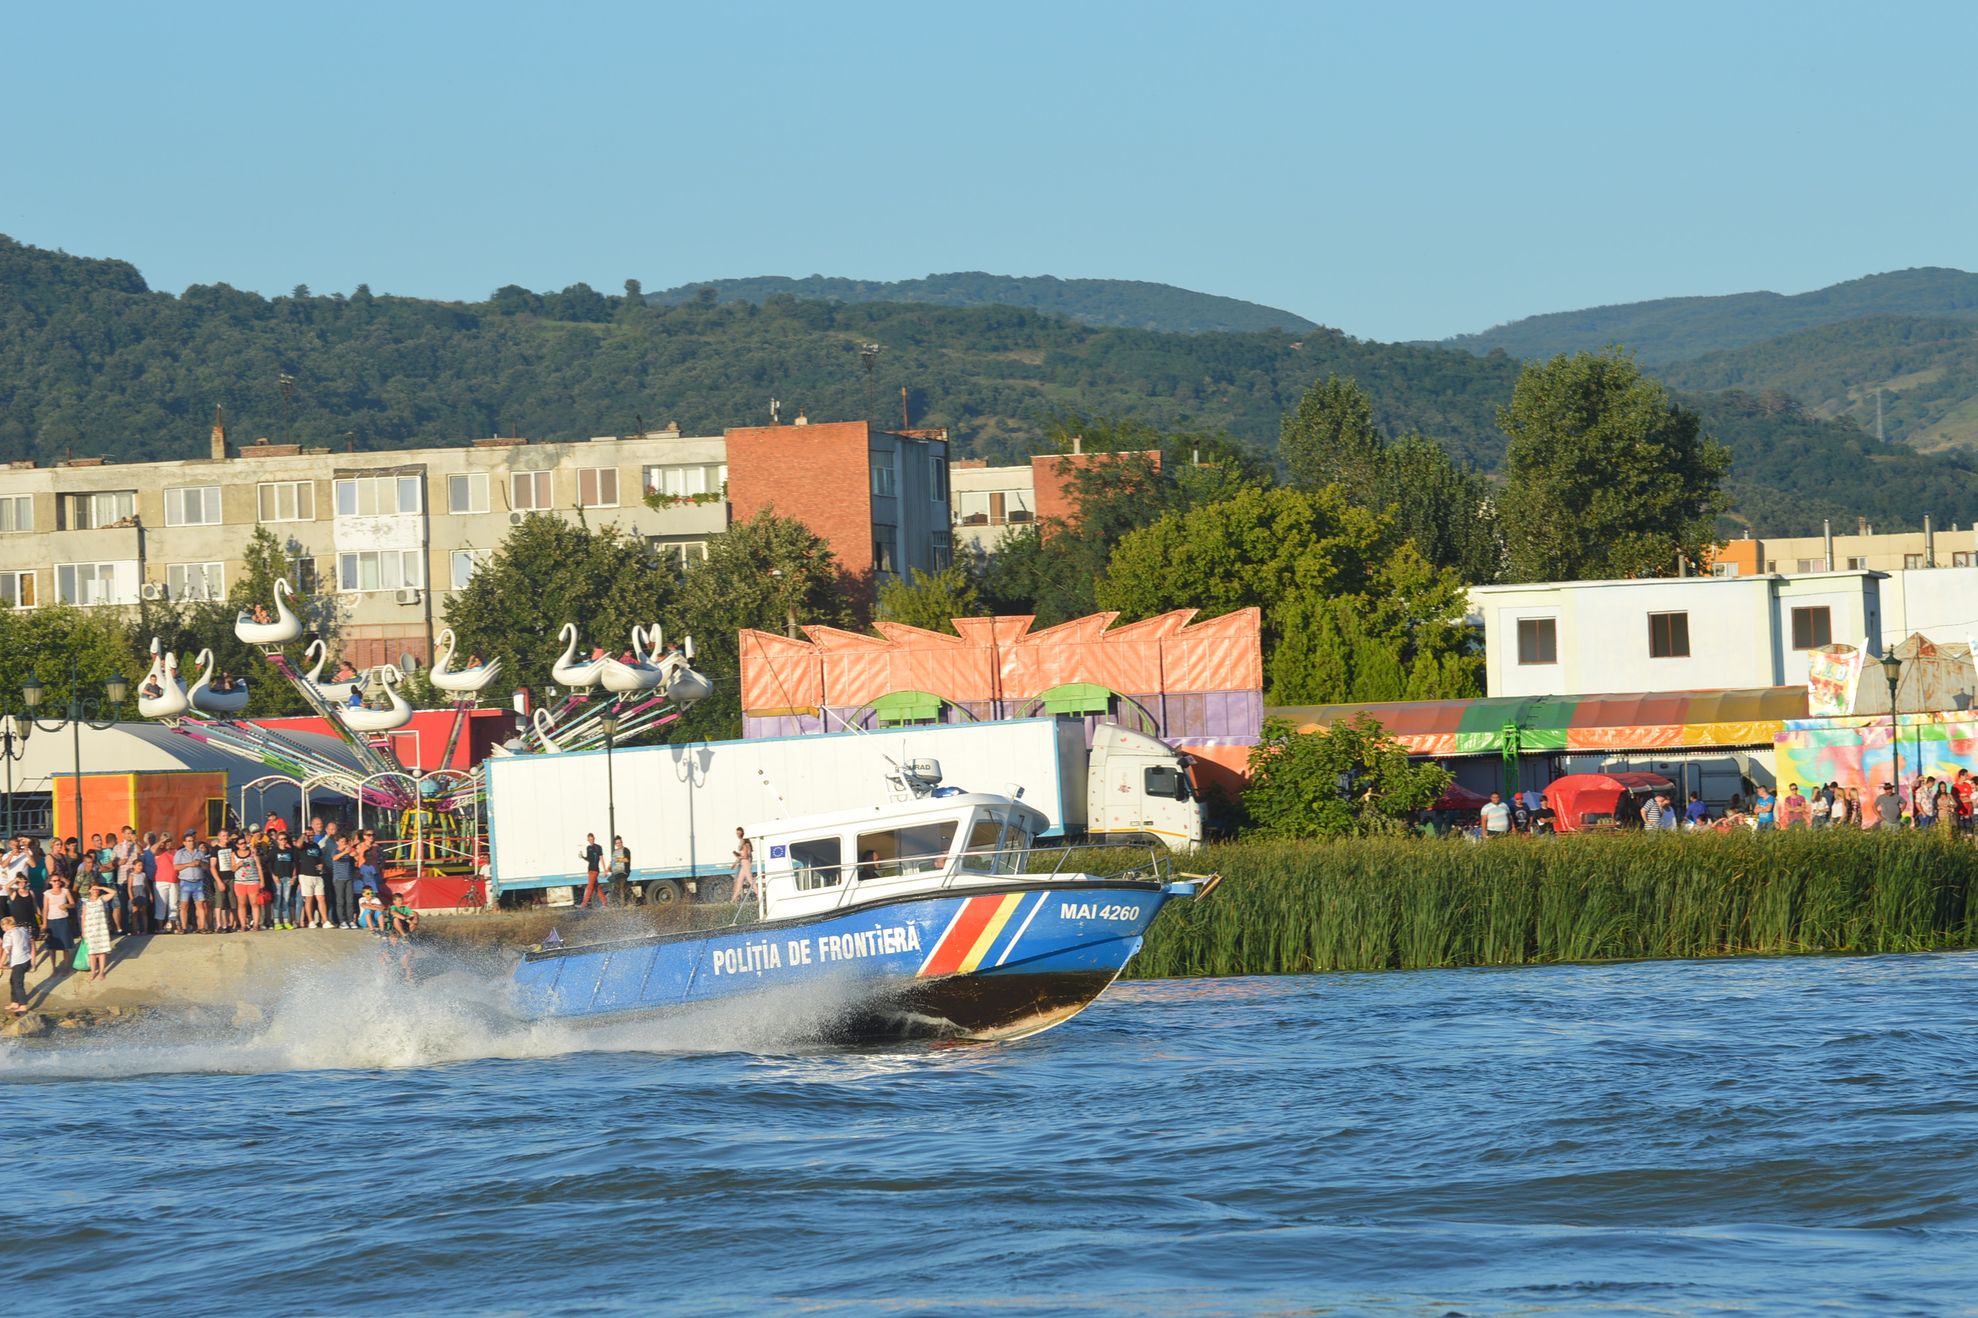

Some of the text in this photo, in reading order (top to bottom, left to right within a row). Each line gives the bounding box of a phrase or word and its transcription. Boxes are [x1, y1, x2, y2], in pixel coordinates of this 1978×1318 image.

[1060, 903, 1140, 921] MAI 4260
[788, 939, 812, 967] DE
